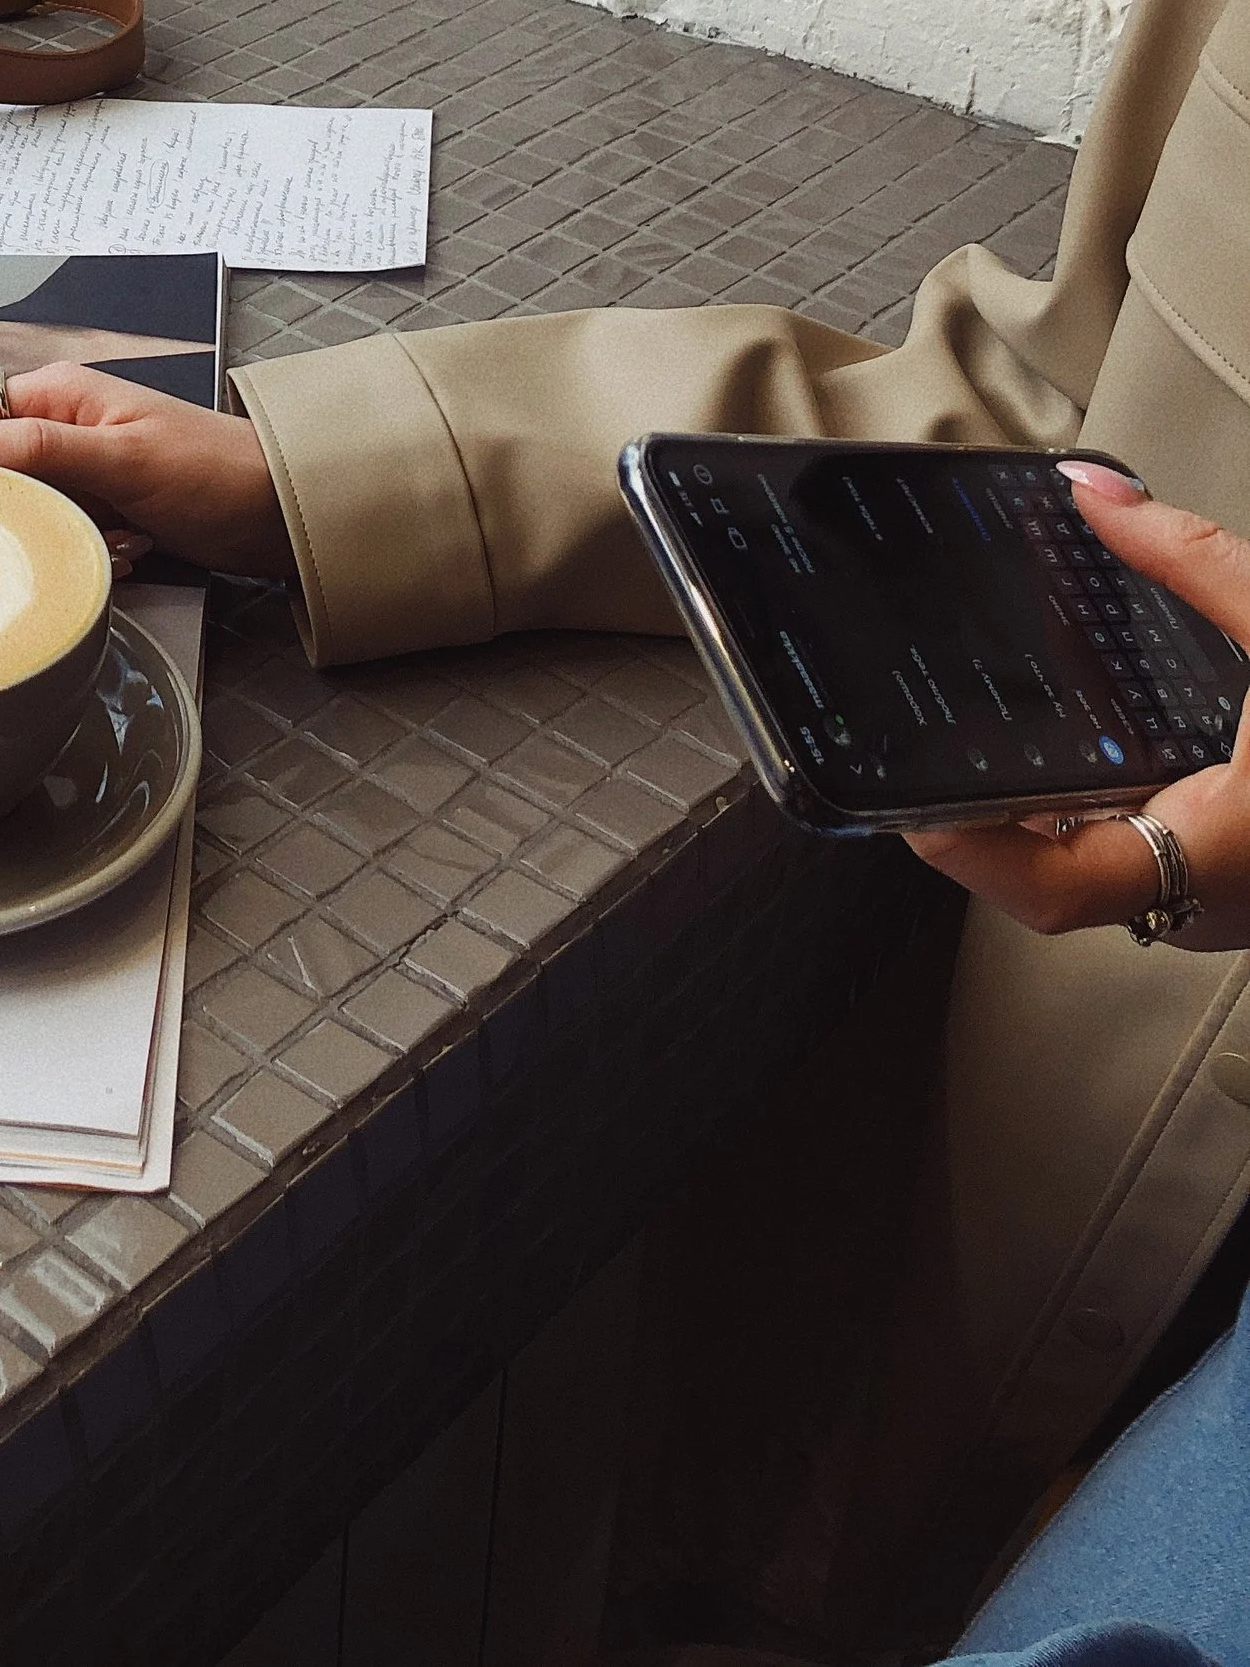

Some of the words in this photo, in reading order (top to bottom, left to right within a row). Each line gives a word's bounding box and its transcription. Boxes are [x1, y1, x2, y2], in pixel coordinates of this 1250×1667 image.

[891, 670, 928, 726] Хорошо)
[927, 678, 957, 725] Люблю
[981, 672, 1013, 721] Почему
[799, 726, 825, 765] 15:55
